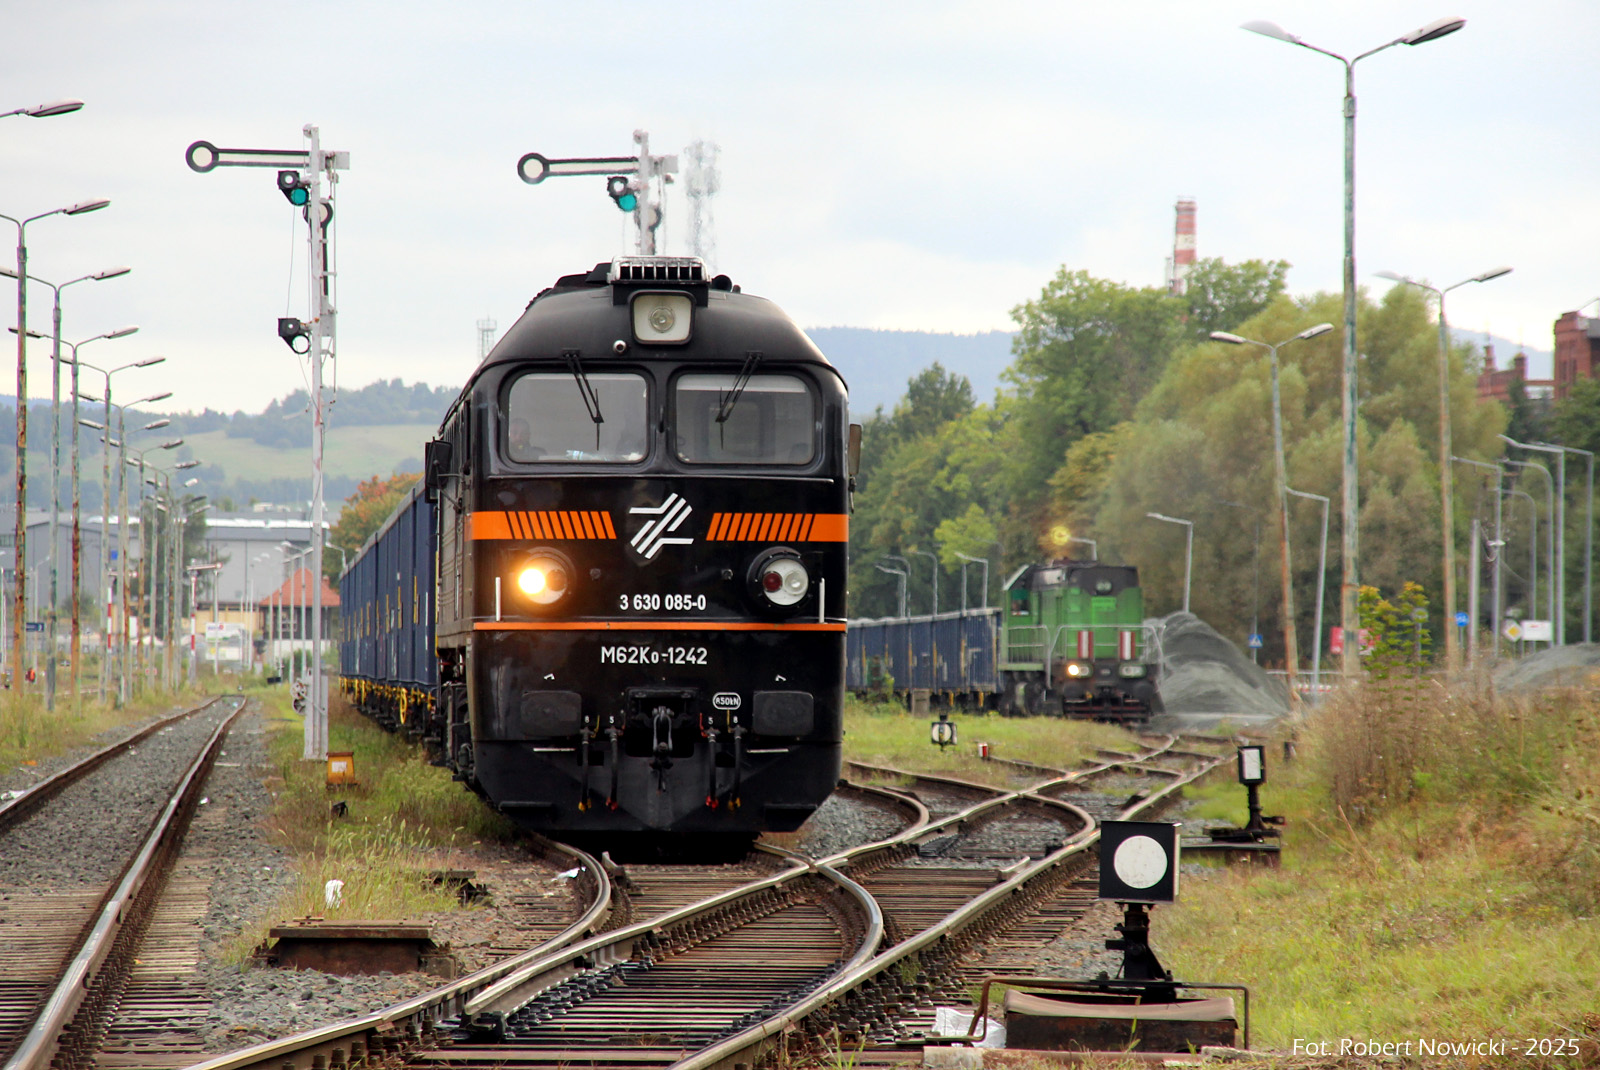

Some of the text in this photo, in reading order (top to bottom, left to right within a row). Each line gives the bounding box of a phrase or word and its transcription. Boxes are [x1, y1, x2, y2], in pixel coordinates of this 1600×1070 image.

[619, 594, 707, 611] 3 630 085-0
[601, 646, 708, 665] M62Ko-1242
